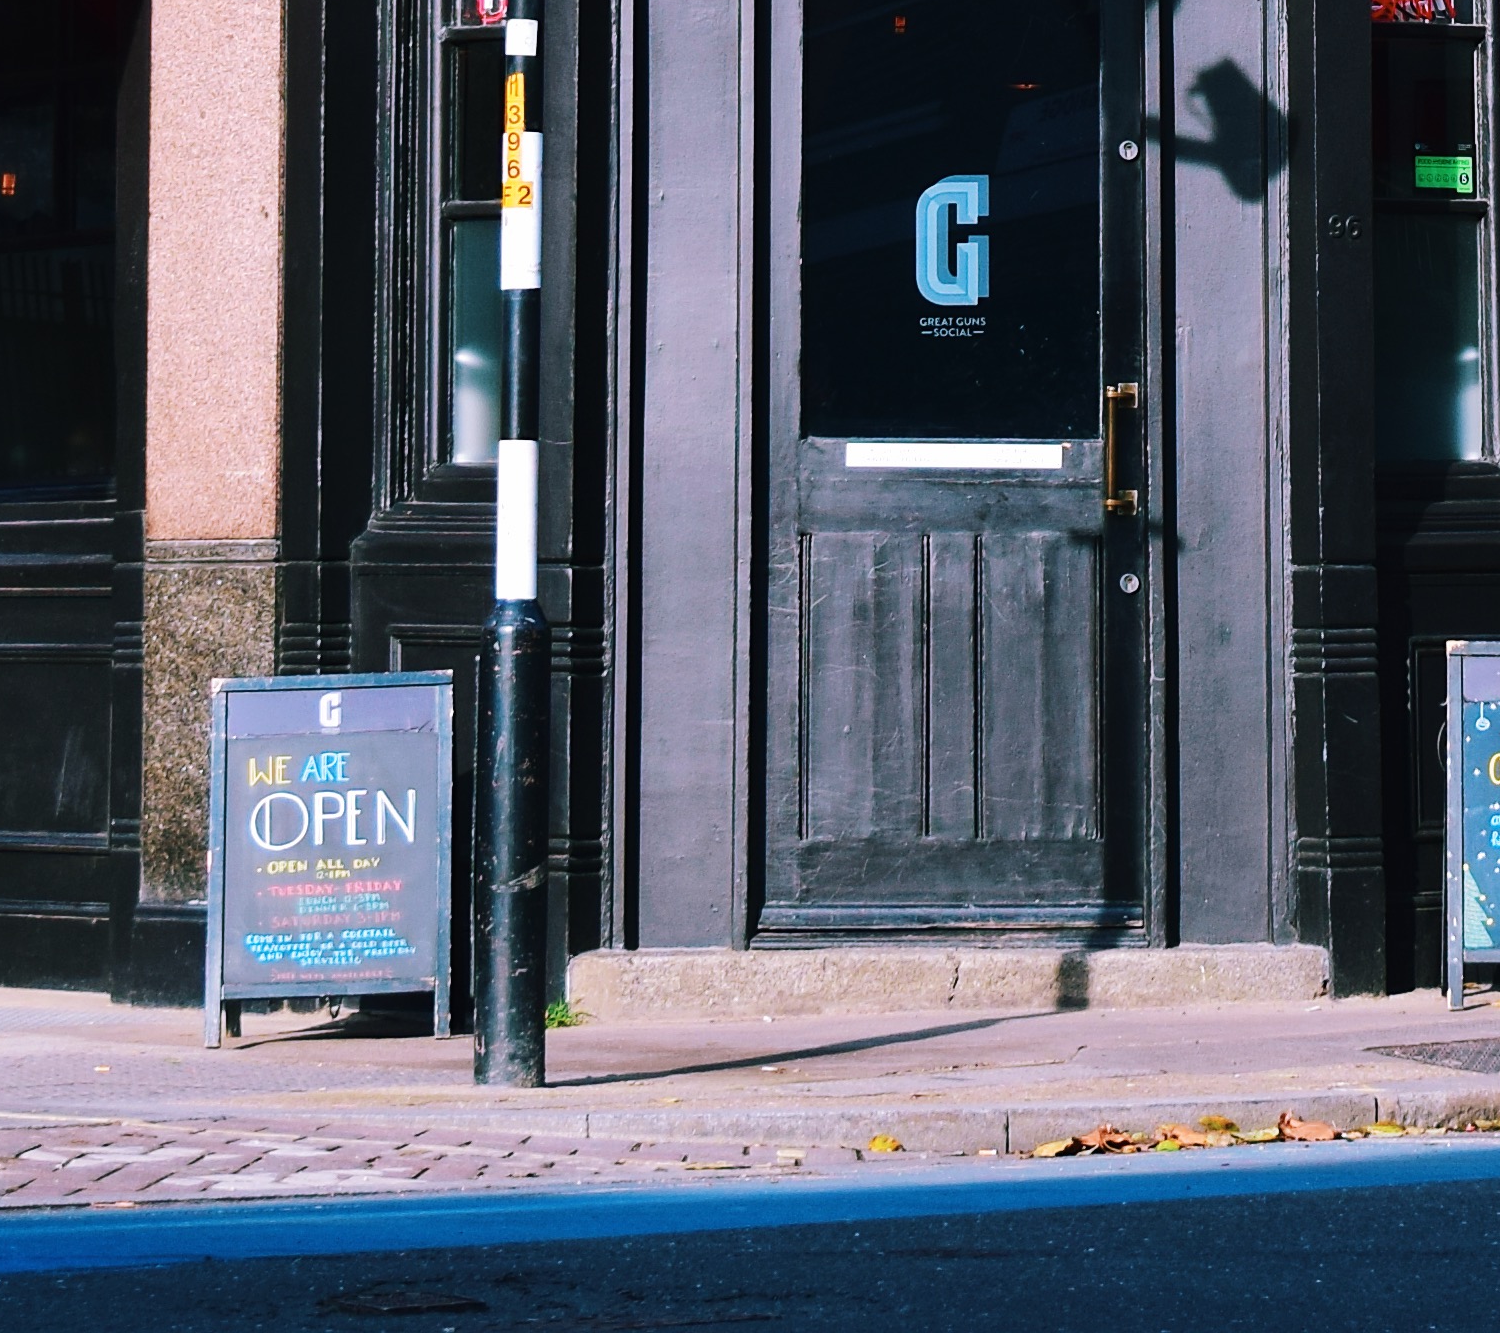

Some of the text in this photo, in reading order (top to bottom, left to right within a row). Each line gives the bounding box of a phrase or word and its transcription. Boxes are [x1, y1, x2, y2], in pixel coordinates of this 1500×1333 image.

[919, 316, 986, 327] GREAT GUNS
[933, 327, 973, 338] SOCIAL
[248, 752, 350, 787] WE ARE
[250, 789, 416, 851] OPEN
[267, 857, 381, 875] OPEN ALL DAY
[345, 880, 402, 894] FRIDAY
[272, 914, 350, 929] SATURDAY
[342, 928, 396, 939] COCKTAIL
